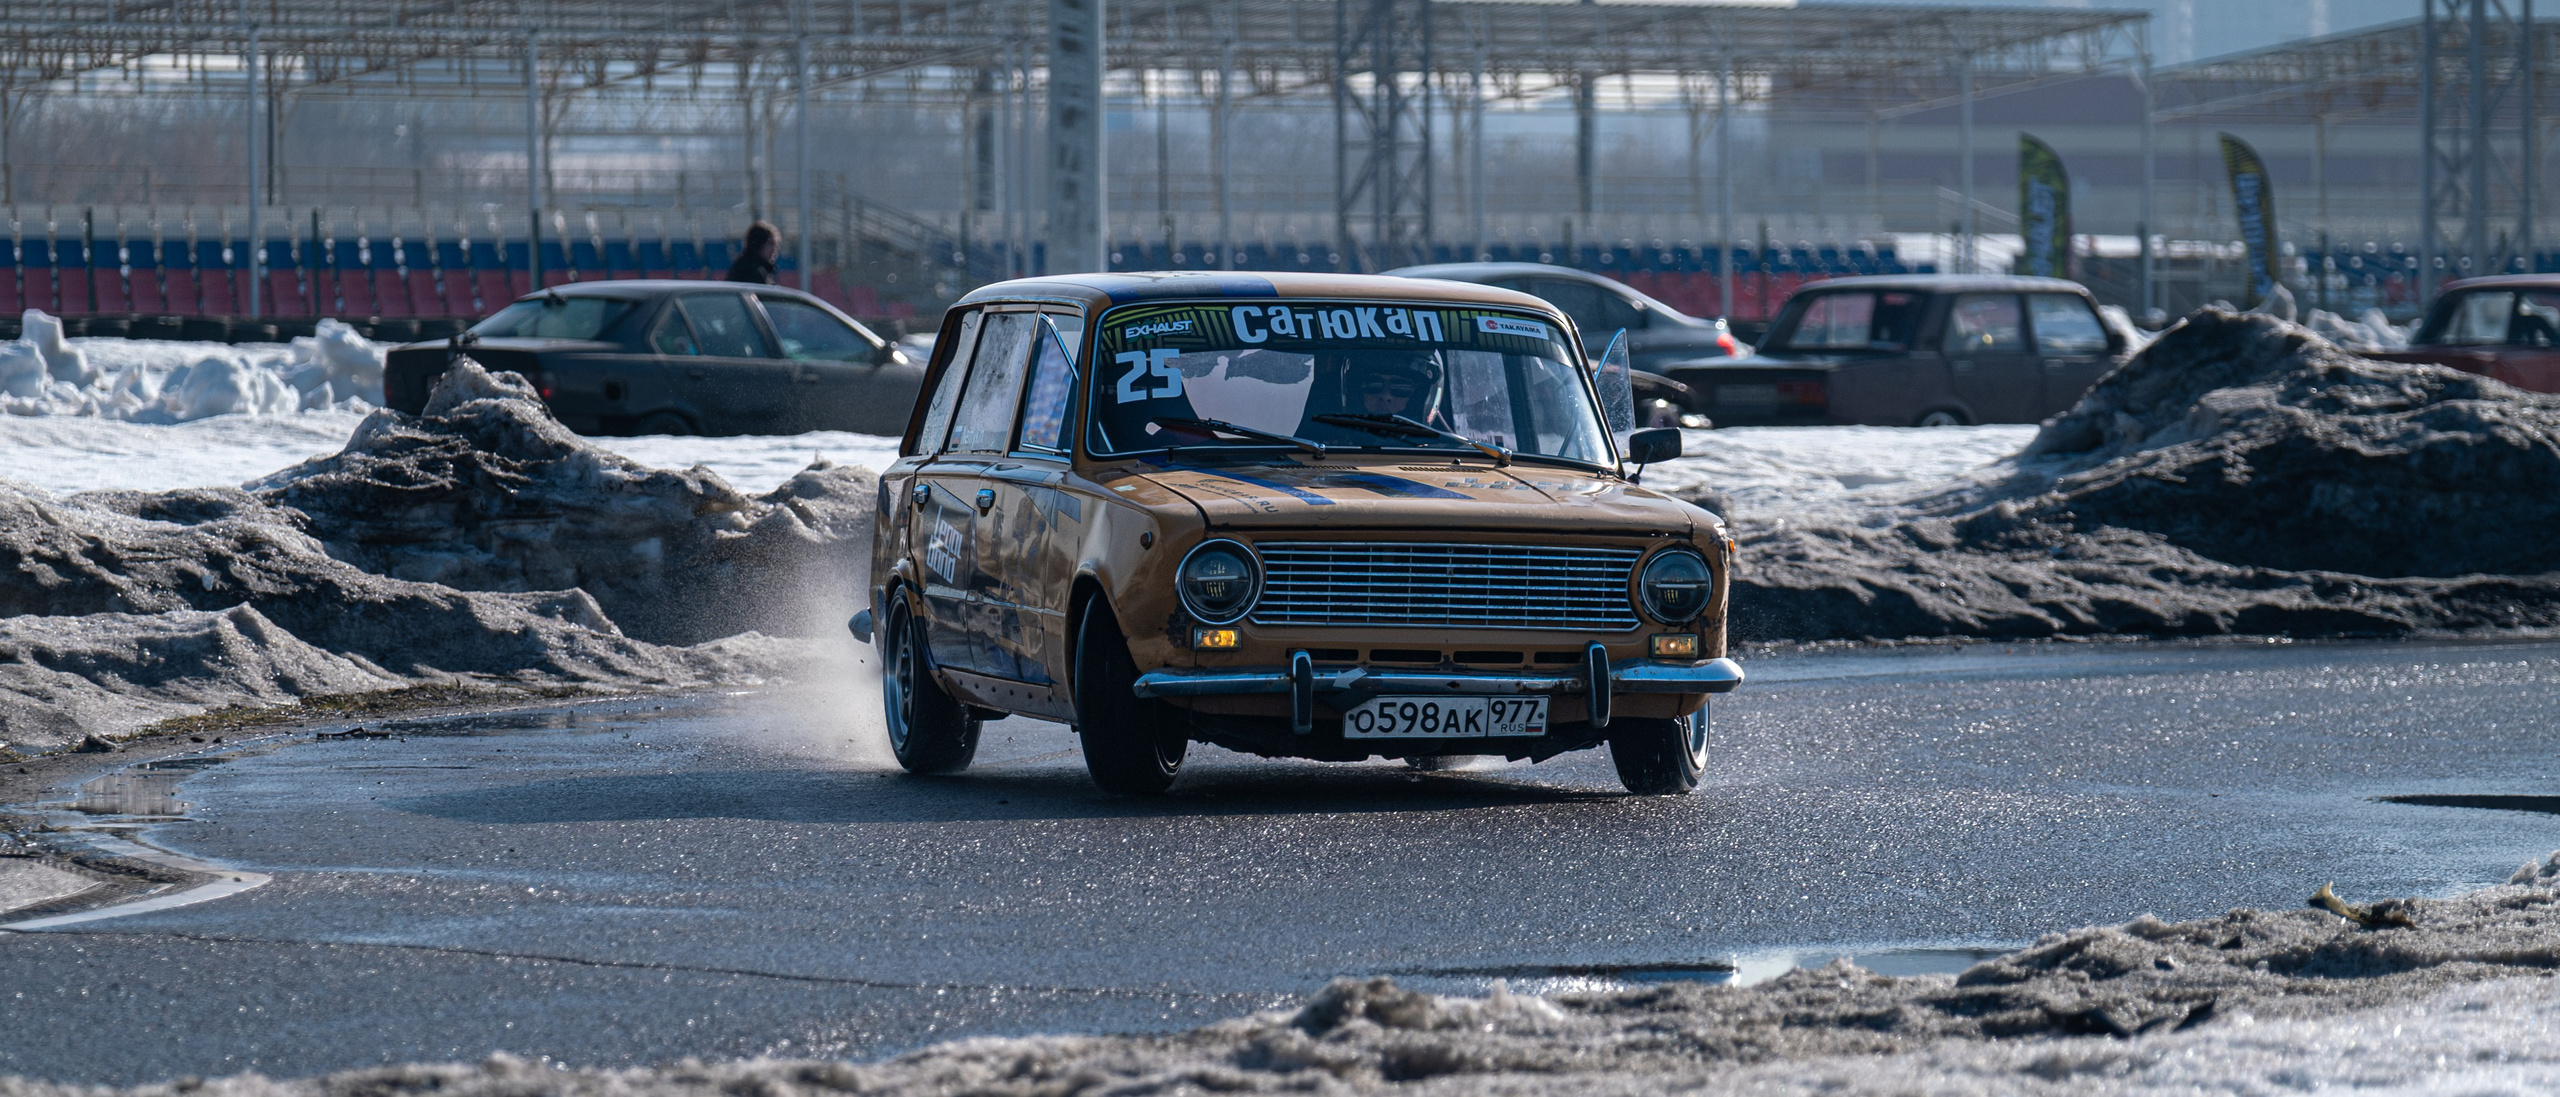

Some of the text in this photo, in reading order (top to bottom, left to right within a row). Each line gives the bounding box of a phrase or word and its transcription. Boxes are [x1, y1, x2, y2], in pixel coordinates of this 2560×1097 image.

[1125, 320, 1192, 339] EXHAUST
[1499, 323, 1541, 334] TAKAYAMA
[1115, 348, 1183, 404] 25
[1490, 700, 1540, 724] 977
[1500, 723, 1525, 733] RUS
